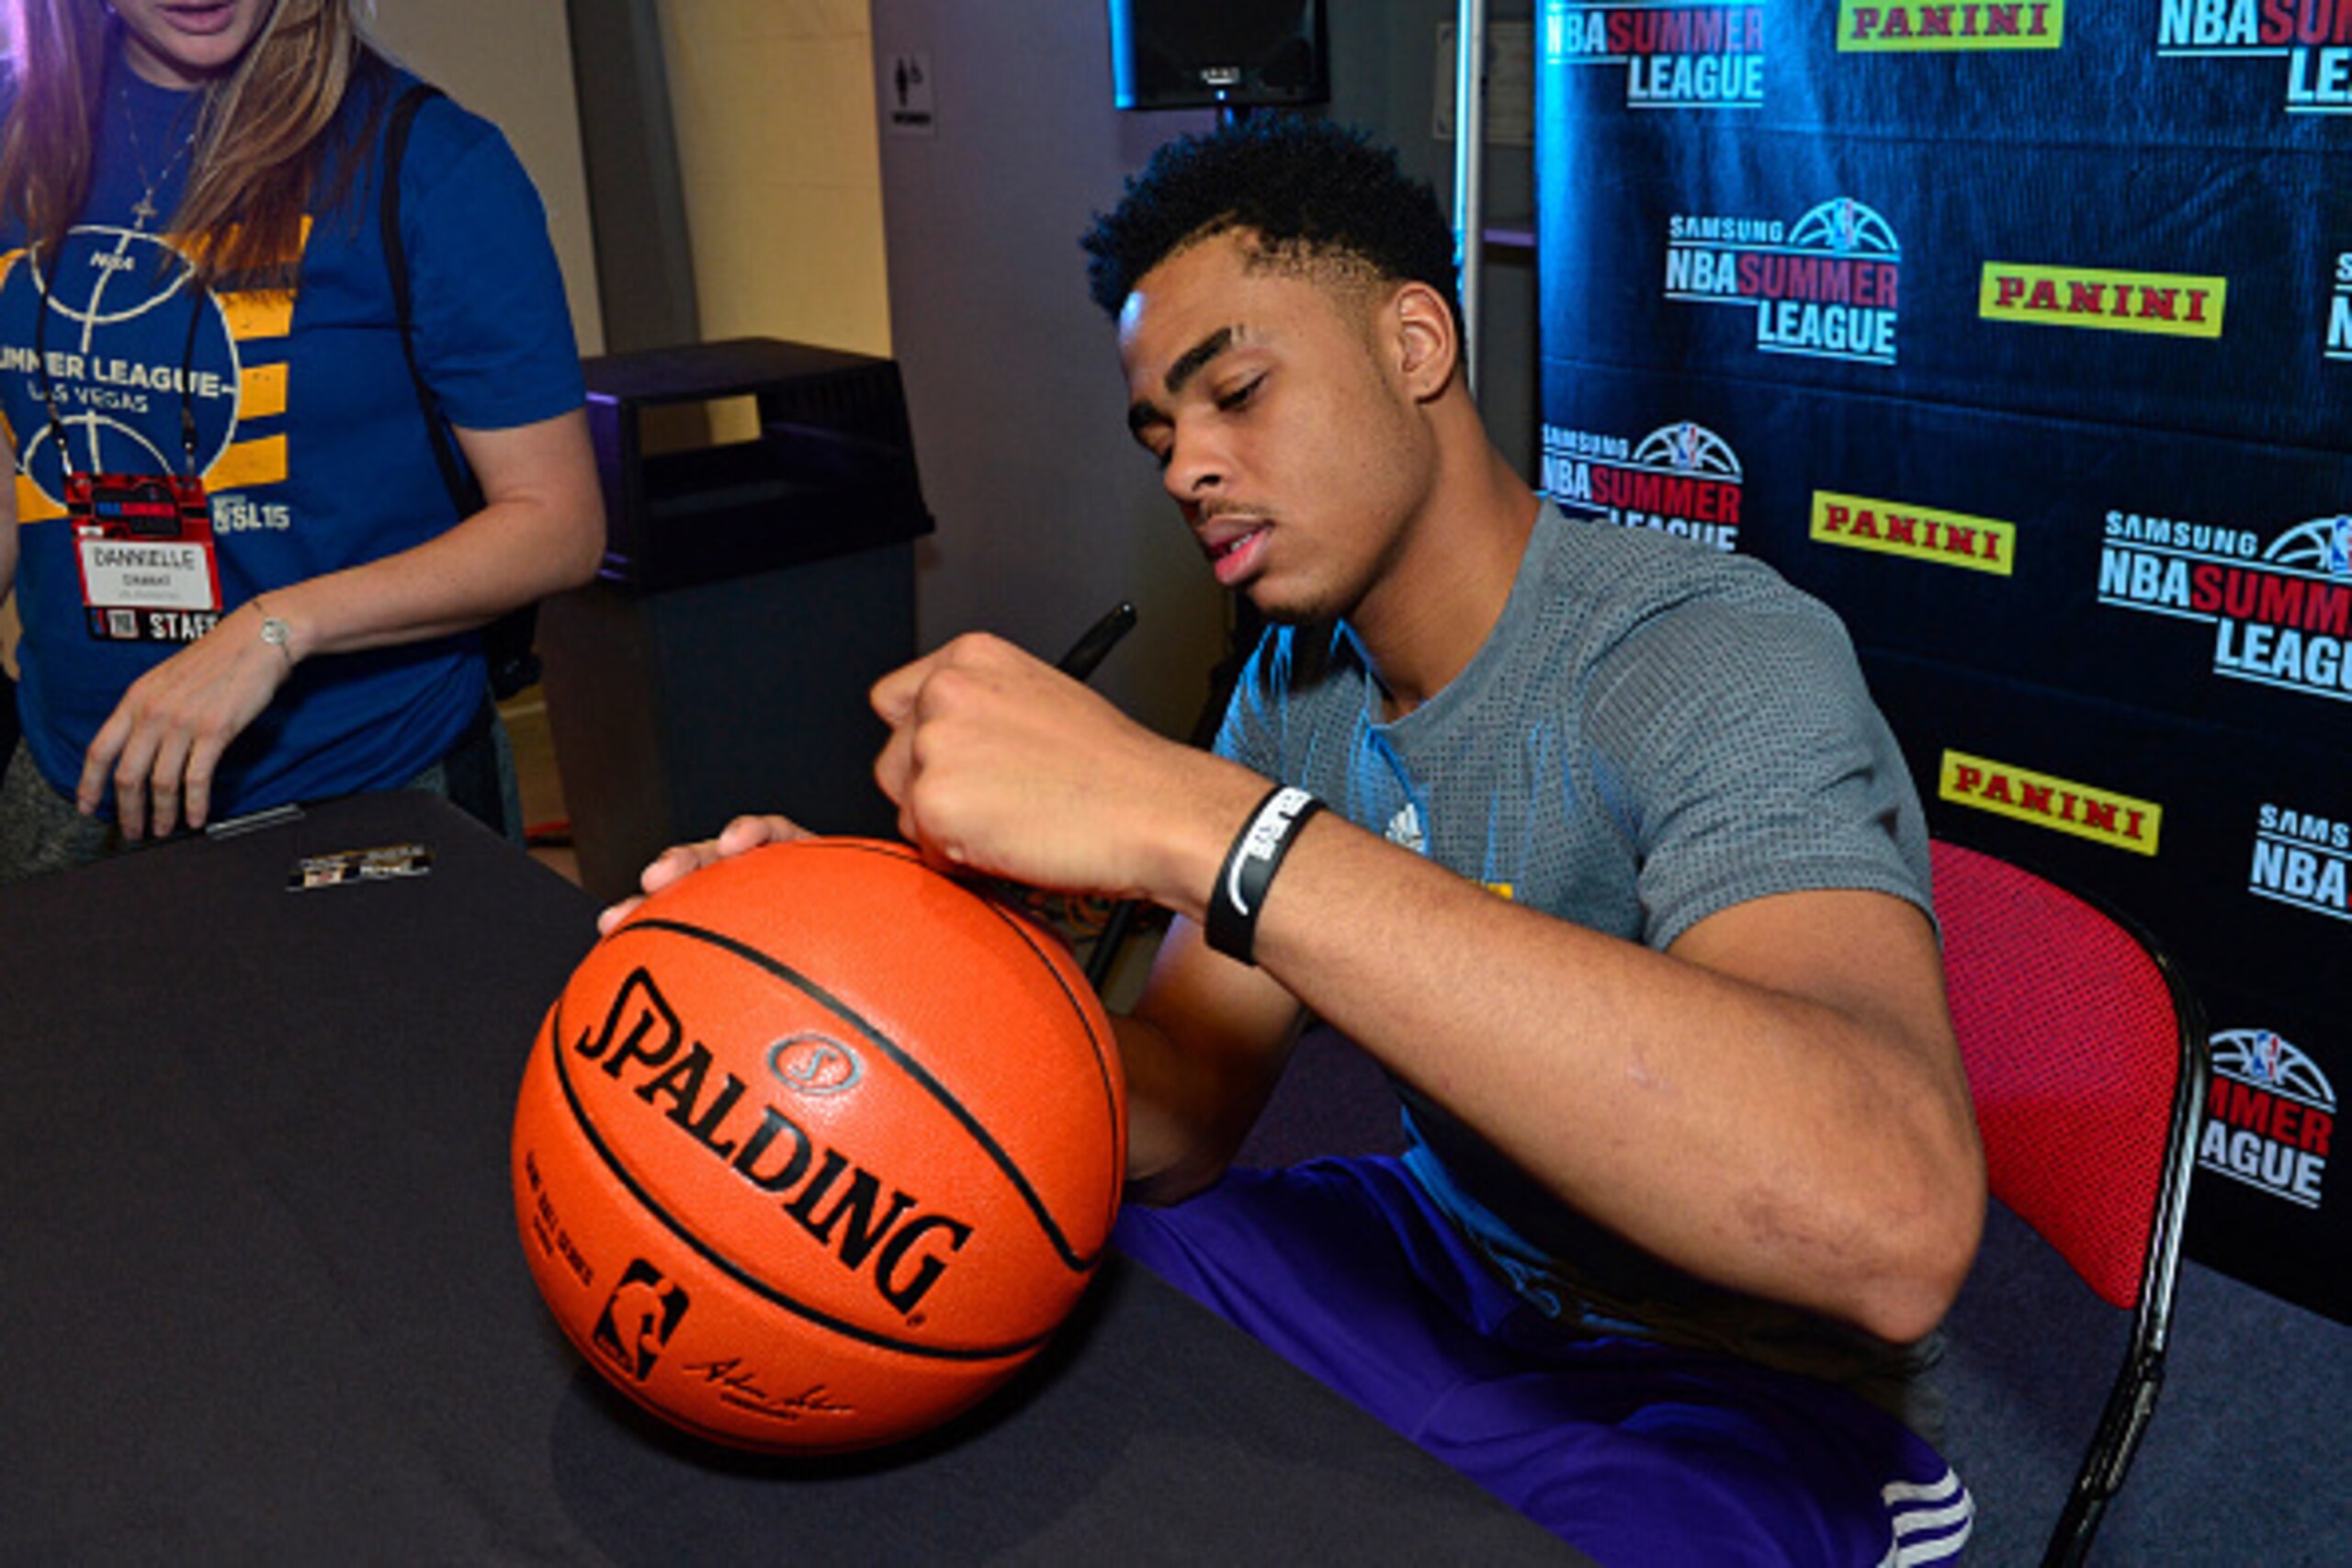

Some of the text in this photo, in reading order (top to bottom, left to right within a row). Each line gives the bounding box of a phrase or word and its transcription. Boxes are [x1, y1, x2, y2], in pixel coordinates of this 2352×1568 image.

[1851, 4, 2050, 39] PANINI
[1629, 55, 1764, 98] LEAGUE
[2288, 48, 2352, 101] LE
[1668, 215, 1784, 243] SAMSUNG
[1995, 276, 2209, 322] PANINI
[1758, 299, 1897, 355] LEAGUE
[1824, 502, 2001, 563] PANINI
[2104, 510, 2258, 558] SAMSUNG
[1952, 763, 2146, 841] PANINI
[2258, 802, 2349, 848] SAMS
[574, 966, 976, 1314] SPALDING
